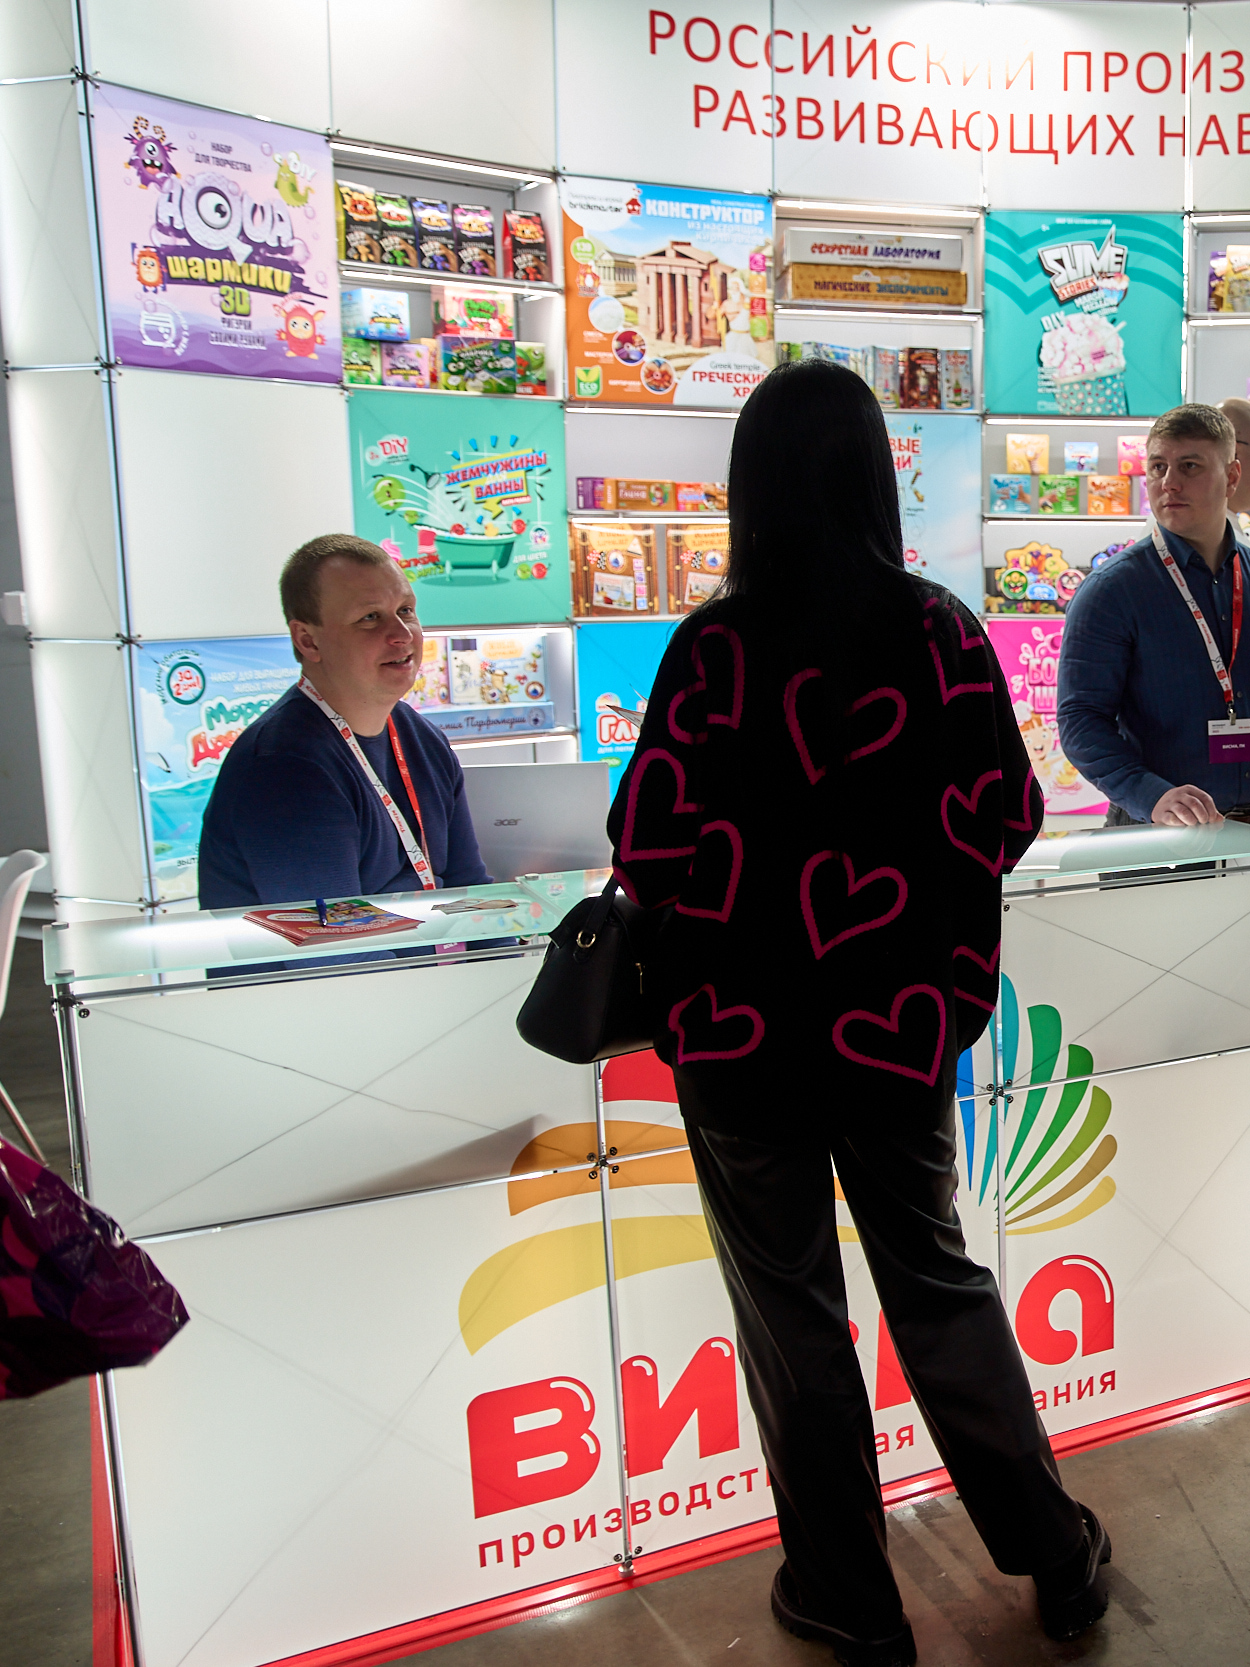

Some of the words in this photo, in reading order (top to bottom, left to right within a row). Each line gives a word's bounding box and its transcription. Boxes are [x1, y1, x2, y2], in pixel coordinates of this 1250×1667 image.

[648, 9, 1035, 91] РОССИЙСКИЙ
[692, 85, 1135, 165] РАЗВИВАЮЩИХ
[156, 172, 294, 265] AQUA
[645, 199, 765, 225] КОНСТРУКТОР
[873, 246, 941, 260] ЛАБОРАТОРИЯ
[219, 285, 251, 316] 3D
[1040, 311, 1066, 331] DIY
[579, 382, 598, 390] ECO
[733, 386, 752, 398] ХР
[888, 437, 920, 454] ВЫЕ
[445, 452, 547, 486] ЖЕМЧУЖИНЫ
[474, 478, 524, 499] ВАННЫ
[206, 699, 273, 731] Морс
[494, 817, 522, 827] acer
